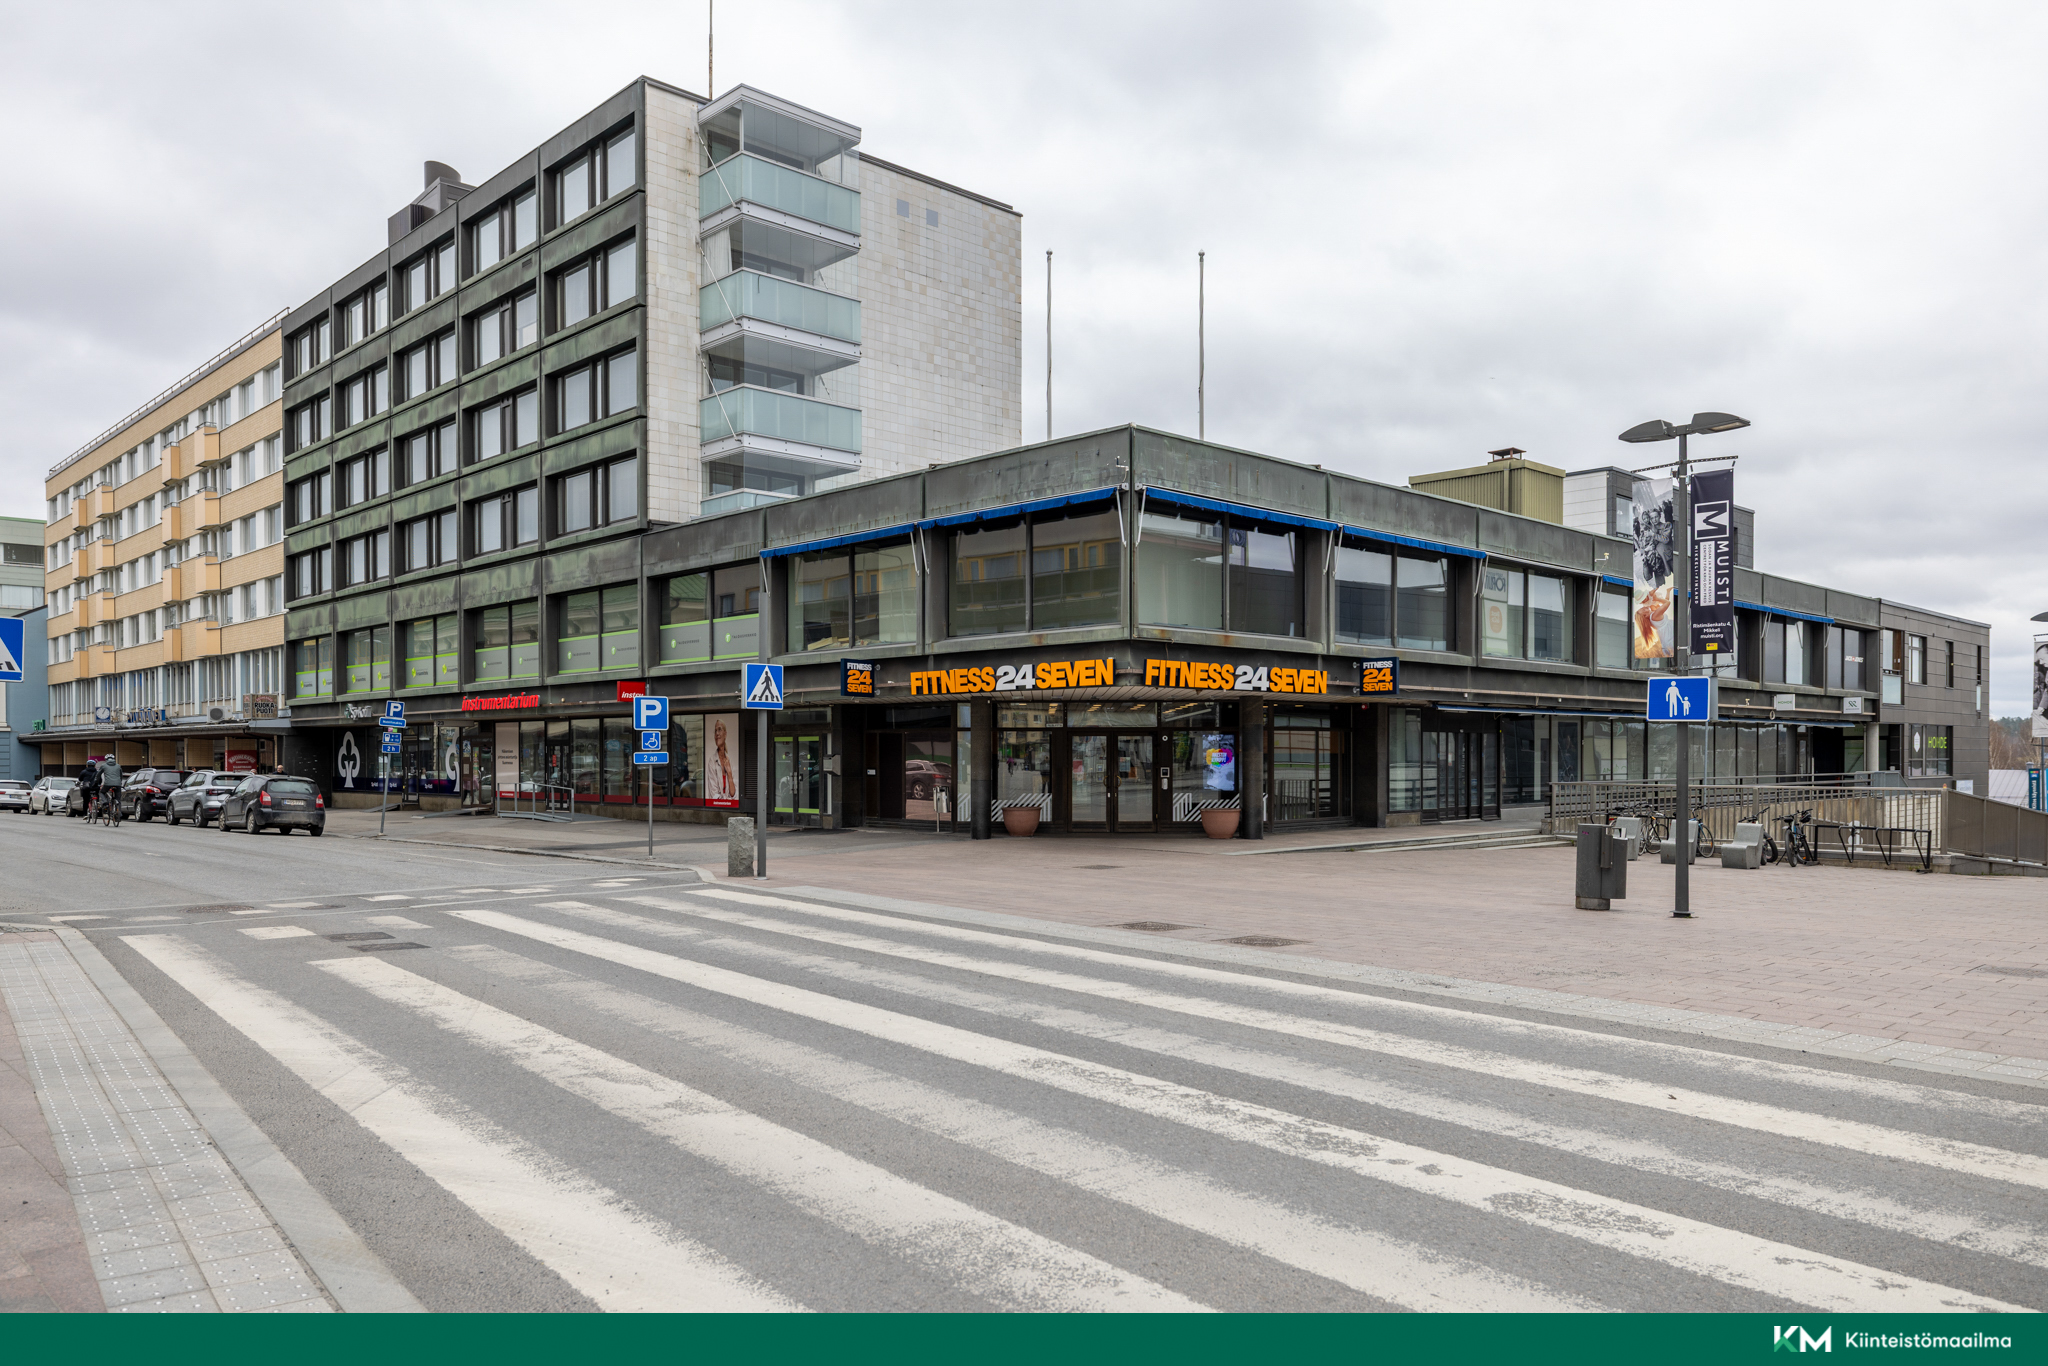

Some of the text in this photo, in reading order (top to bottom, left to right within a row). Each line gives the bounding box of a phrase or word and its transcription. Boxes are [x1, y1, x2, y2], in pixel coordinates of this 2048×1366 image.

[1716, 541, 1730, 604] MUISTI
[847, 662, 872, 671] FITNESS
[1363, 661, 1393, 669] FITNESS
[847, 670, 872, 685] 24
[1363, 668, 1393, 683] 24
[847, 684, 873, 694] SEVEN
[1363, 682, 1393, 692] SEVEN
[461, 692, 540, 711] instrumentarium
[640, 699, 662, 727] P
[650, 755, 658, 763] ap
